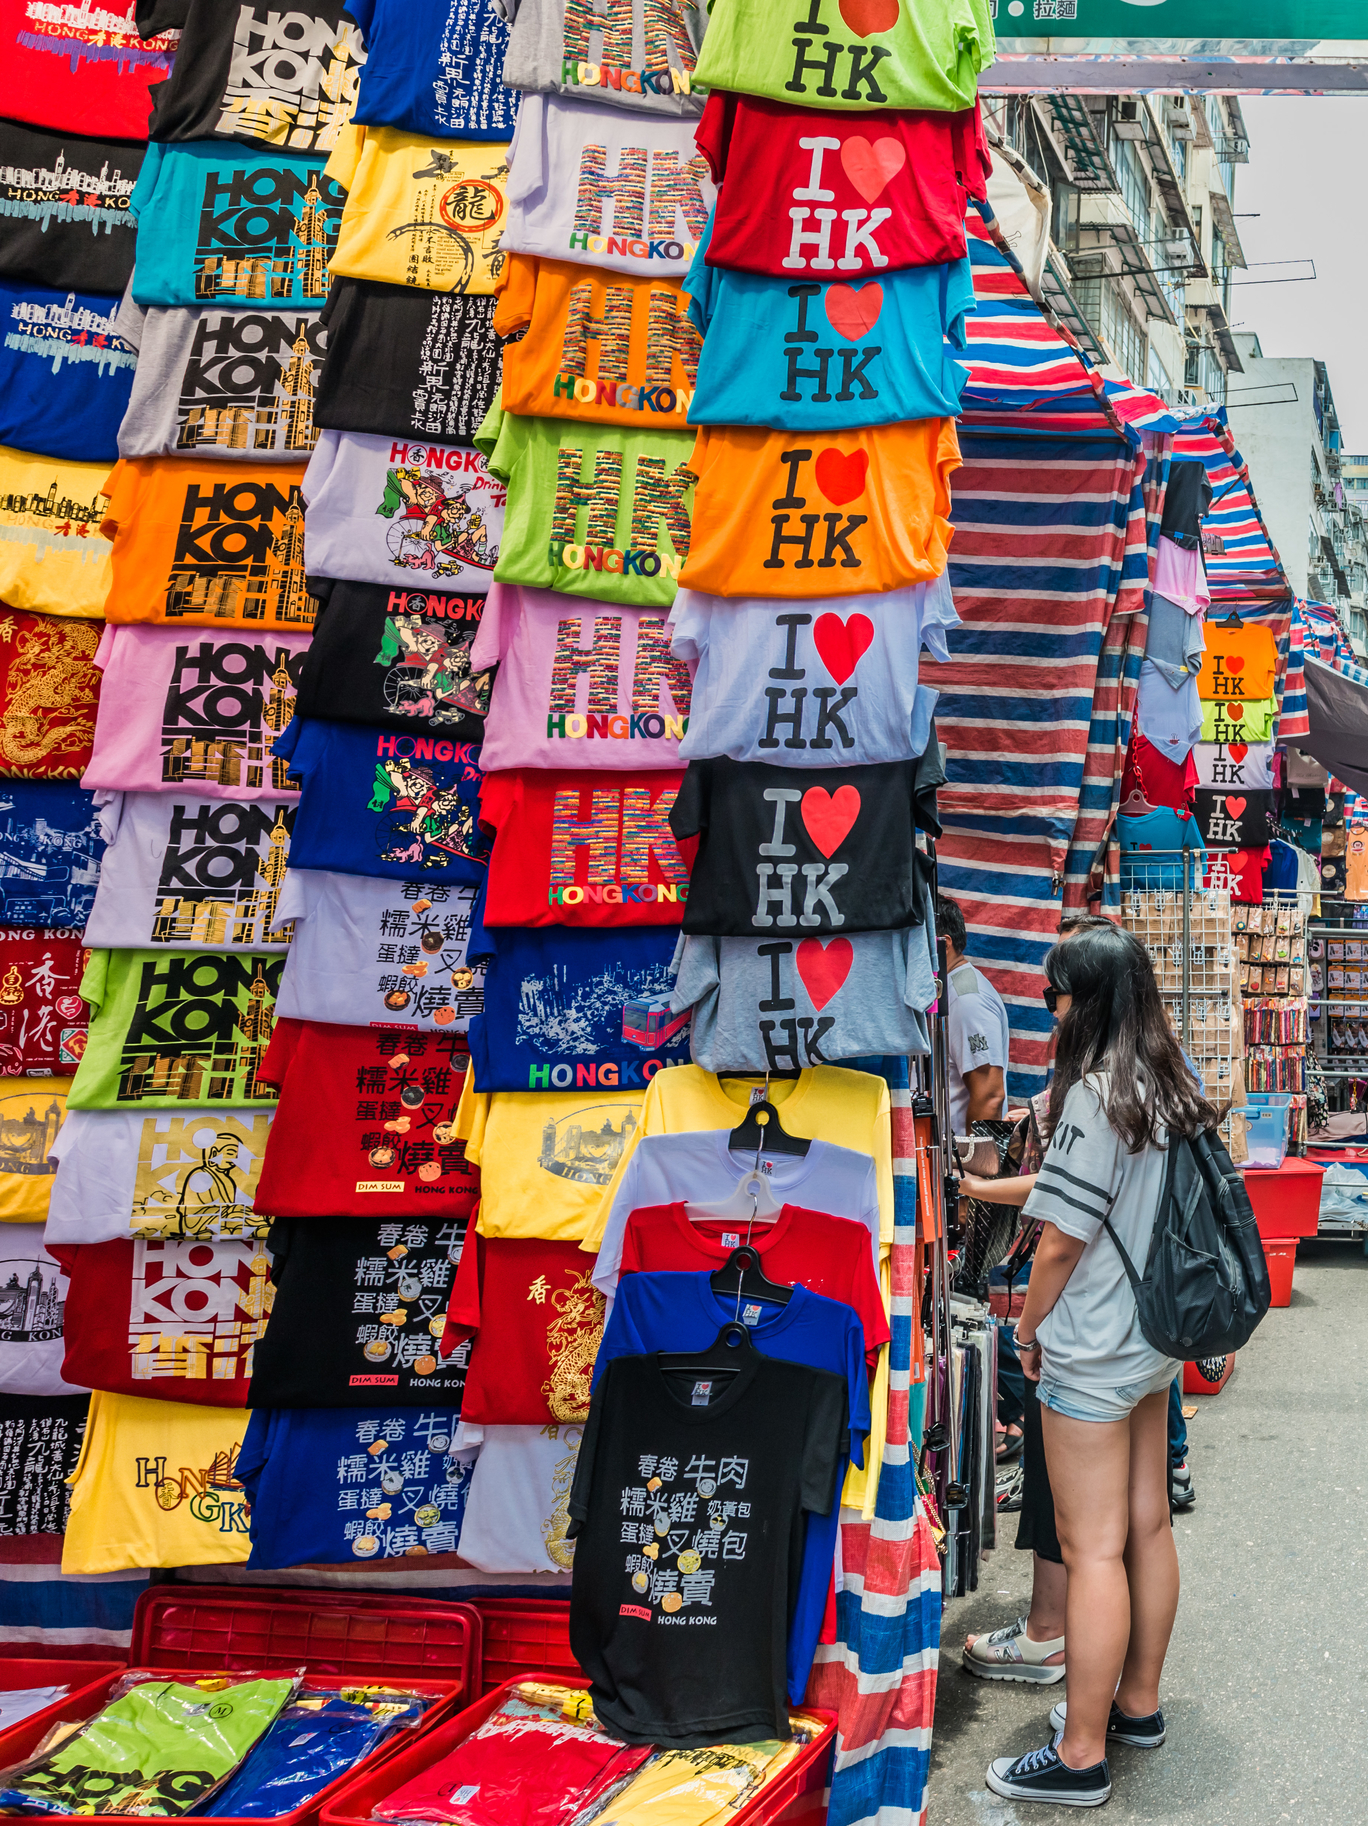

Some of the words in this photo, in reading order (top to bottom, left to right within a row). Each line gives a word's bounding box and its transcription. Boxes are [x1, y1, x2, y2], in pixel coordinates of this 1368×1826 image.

[794, 0, 830, 36] I
[1034, 0, 1077, 19] 拉麵
[35, 21, 89, 40] HONG
[129, 37, 178, 51] KONG
[785, 37, 893, 103] HK
[792, 136, 841, 202] I
[8, 188, 60, 201] HONG
[445, 185, 496, 221] 龍
[782, 207, 893, 270] HK
[784, 283, 821, 343] I
[18, 322, 72, 341] HONG
[780, 346, 882, 403] HK
[772, 449, 814, 510] I
[763, 512, 868, 569] HK
[549, 541, 687, 580] HONGKON
[768, 613, 812, 681] I
[1213, 655, 1224, 675] I
[1212, 676, 1245, 695] HK
[758, 687, 858, 749] HK
[1214, 702, 1226, 723] I
[1214, 724, 1245, 743] HK
[1214, 743, 1227, 761] I
[1211, 764, 1245, 784] HK
[1211, 795, 1226, 818] I
[758, 787, 802, 857] I
[1206, 819, 1243, 842] HK
[43, 836, 82, 848] KONG
[752, 863, 849, 927] HK
[379, 909, 471, 942] 糯米雞
[376, 943, 421, 965] 蛋撻
[758, 942, 793, 1012] I
[377, 974, 419, 994] 蝦餃
[411, 985, 484, 1020] 燒賣
[376, 1033, 428, 1056] 春卷
[759, 1016, 836, 1071] HK
[968, 1033, 989, 1052] NY
[356, 1066, 452, 1095] 糯米雞
[355, 1101, 402, 1121] 蛋撻
[360, 1132, 401, 1152] 蝦餃
[397, 1140, 472, 1176] 燒賣
[415, 1186, 445, 1194] HONG
[449, 1186, 478, 1194] KONG
[562, 1167, 611, 1185] HONG
[377, 1223, 429, 1248] 春卷
[354, 1256, 452, 1288] 糯米雞
[352, 1292, 400, 1314] 蛋撻
[526, 1274, 551, 1305] 香
[355, 1324, 400, 1344] 蝦餃
[410, 1378, 441, 1388] HONG
[355, 1418, 406, 1443] 春卷
[337, 1450, 431, 1484] 糯米雞
[638, 1453, 679, 1482] 春卷
[683, 1454, 749, 1490] 牛肉
[337, 1487, 383, 1511] 蛋撻
[620, 1486, 699, 1523] 糯米雞
[707, 1500, 751, 1518] 奶黃包
[343, 1520, 385, 1541] 蝦餃
[382, 1521, 459, 1558] 燒賣
[620, 1521, 654, 1545] 蛋撻
[662, 1529, 748, 1560] 叉燒包
[625, 1554, 654, 1575] 蝦餃
[648, 1568, 715, 1607] 燒賣
[621, 1606, 638, 1614] DIM
[638, 1609, 650, 1618] SUM
[657, 1615, 687, 1625] HONG
[688, 1616, 717, 1625] KONG
[216, 1706, 227, 1715] M
